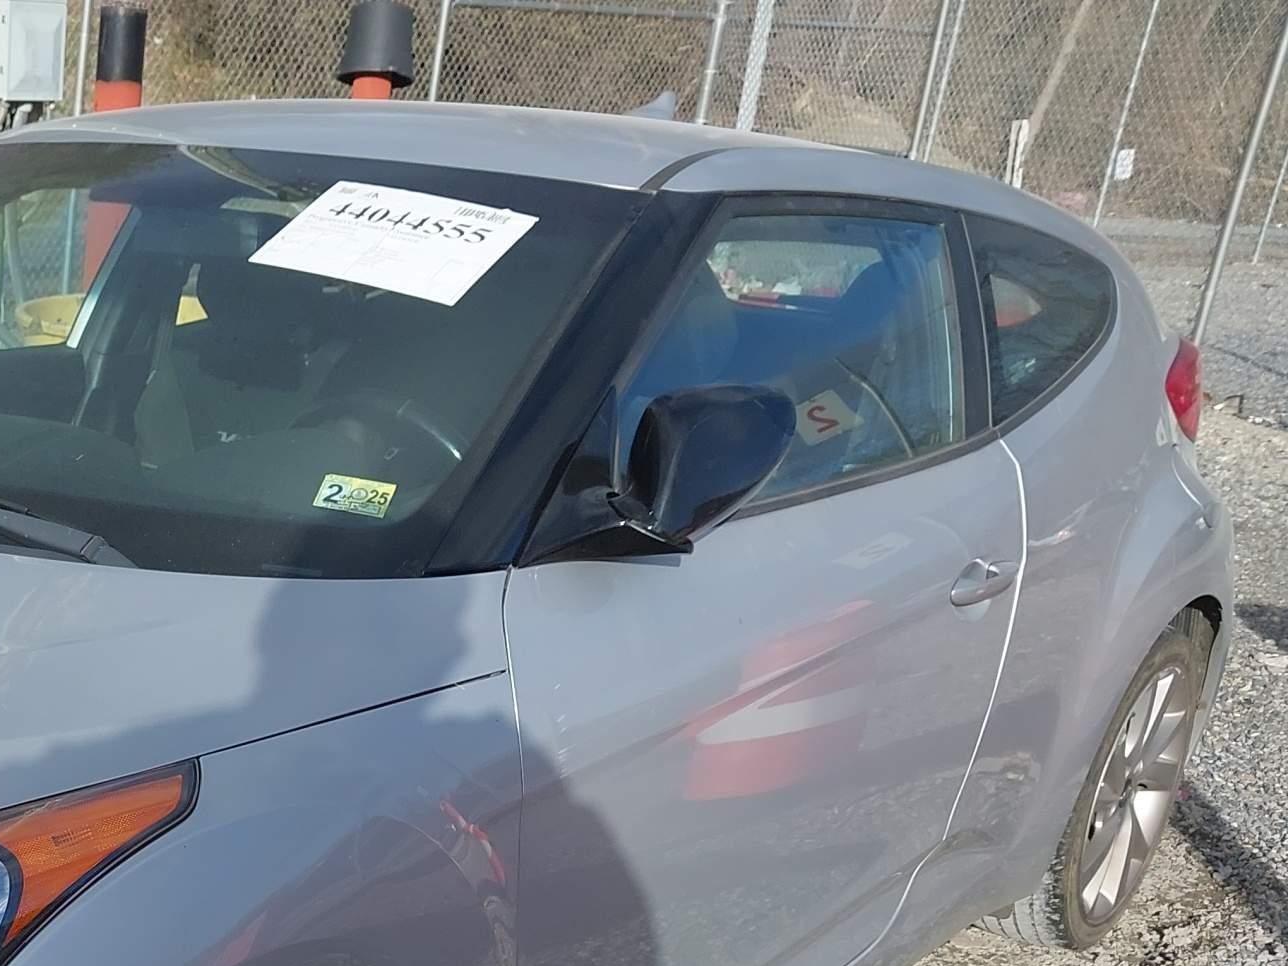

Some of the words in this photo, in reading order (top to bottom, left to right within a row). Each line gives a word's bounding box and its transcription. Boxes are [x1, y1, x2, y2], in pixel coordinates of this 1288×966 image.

[329, 201, 493, 243] 44044555
[322, 484, 343, 503] 2
[366, 489, 390, 506] 25
